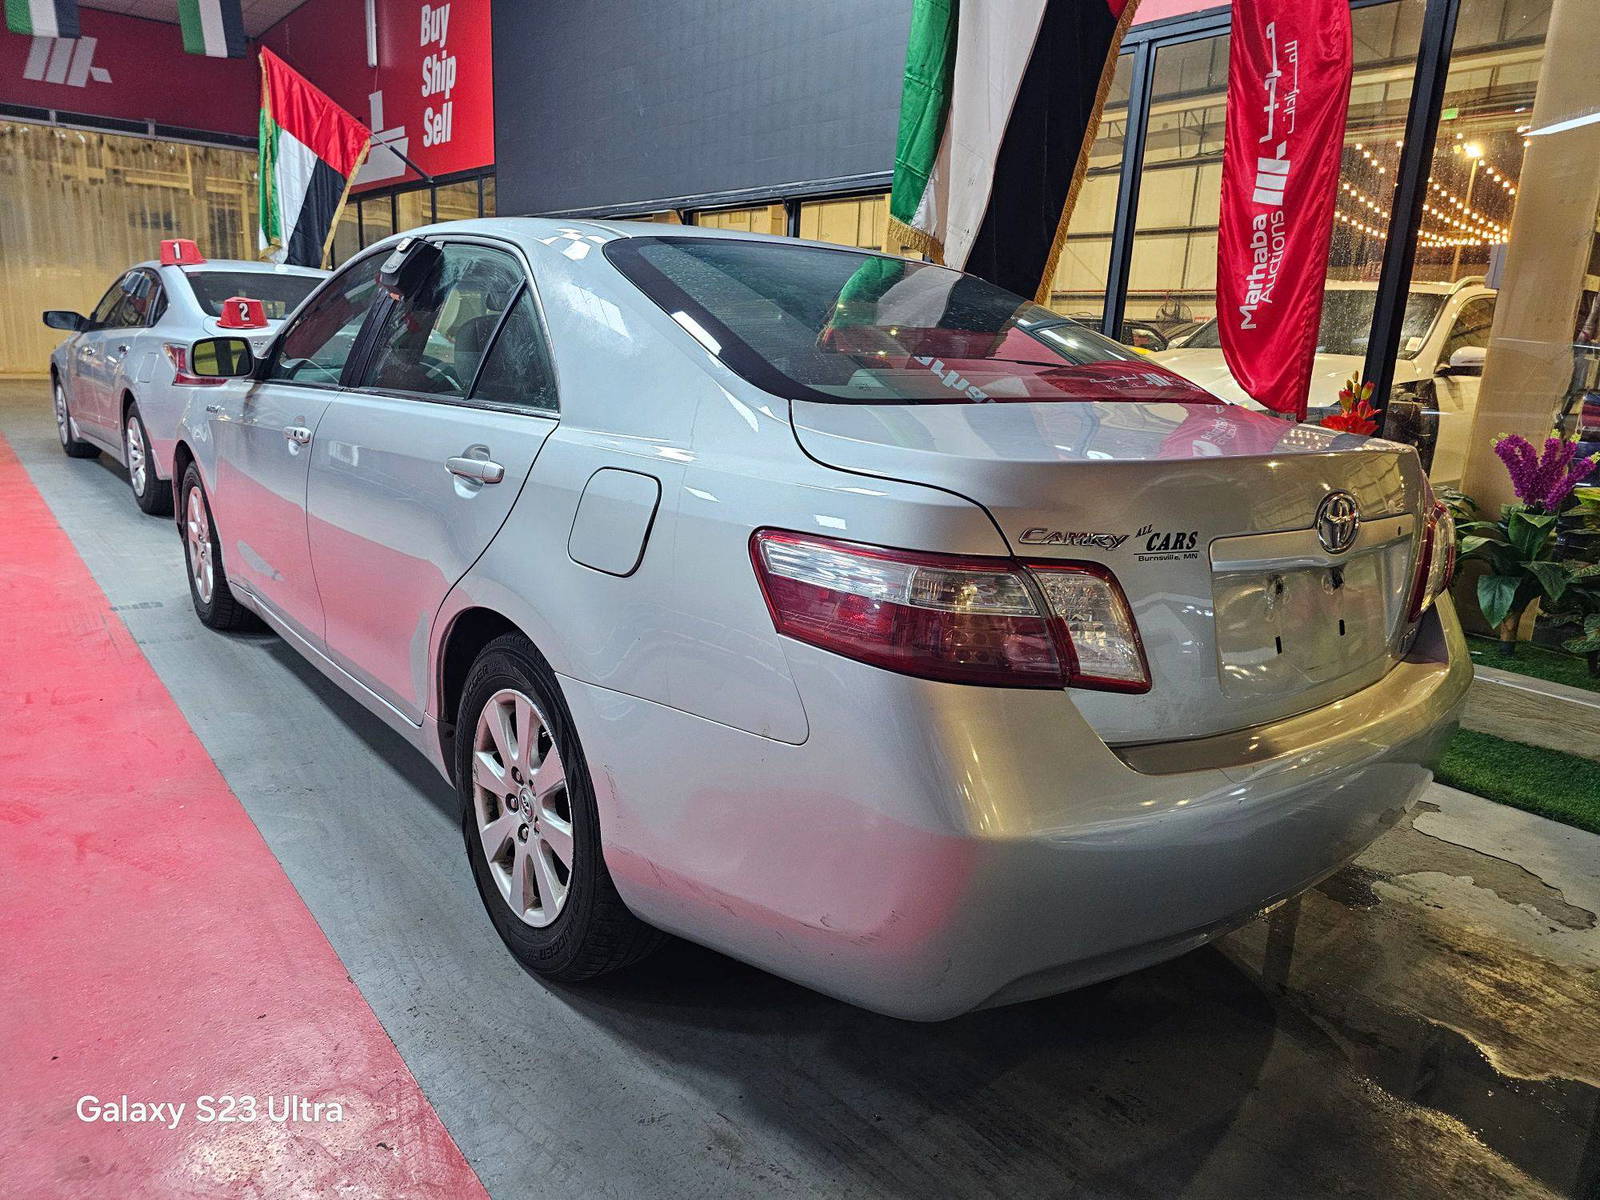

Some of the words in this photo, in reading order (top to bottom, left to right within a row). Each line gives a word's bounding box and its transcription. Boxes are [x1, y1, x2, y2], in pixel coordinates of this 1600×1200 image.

[420, 3, 451, 48] Buy
[422, 50, 456, 99] Ship
[423, 101, 453, 147] Sell
[173, 241, 182, 260] 1
[1259, 210, 1286, 304] Auctions
[1239, 213, 1268, 330] Marhaba
[238, 302, 250, 321] 2
[1018, 527, 1131, 551] CAMRY
[1135, 524, 1153, 538] ALL
[1146, 531, 1198, 551] CARS
